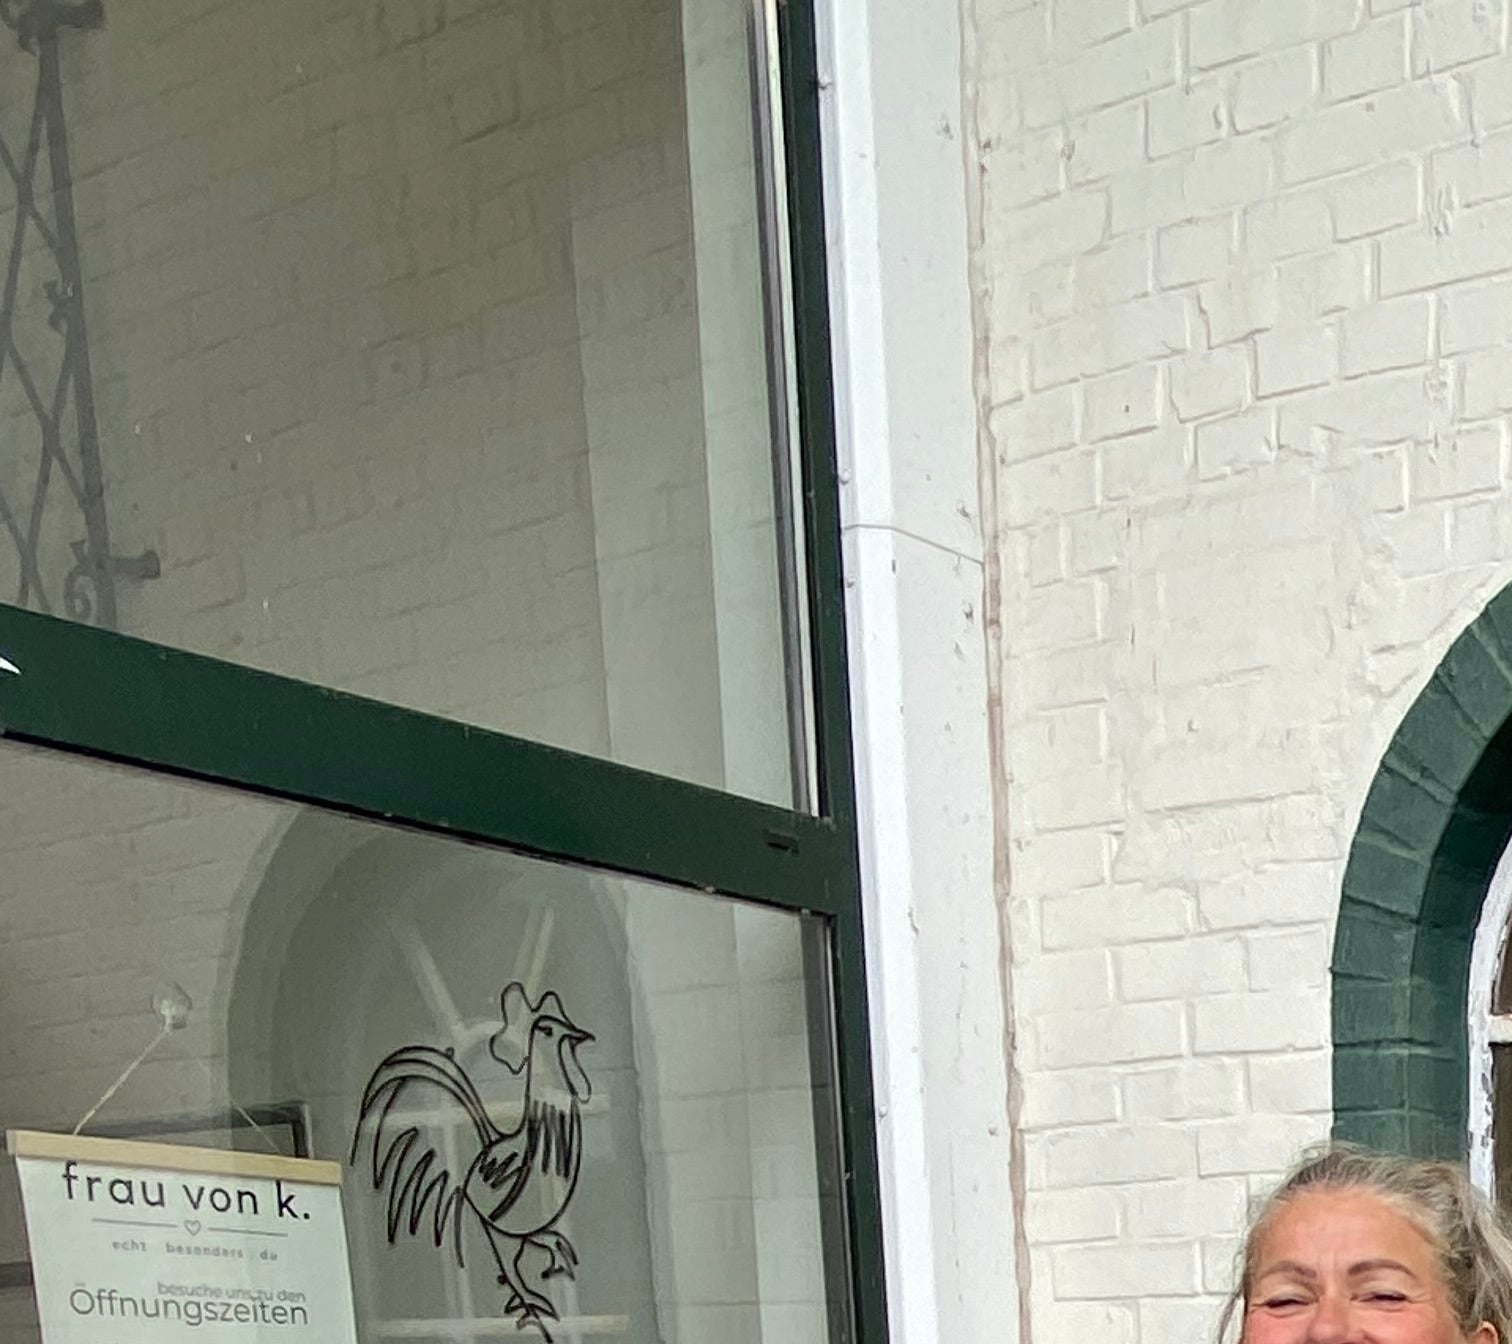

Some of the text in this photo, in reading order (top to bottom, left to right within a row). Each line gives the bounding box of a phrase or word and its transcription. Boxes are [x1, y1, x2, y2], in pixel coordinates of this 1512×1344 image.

[62, 1160, 310, 1220] frau von k.
[70, 1282, 308, 1326] Öffnungszeiten
[157, 1281, 222, 1298] besuche
[276, 1288, 306, 1303] den
